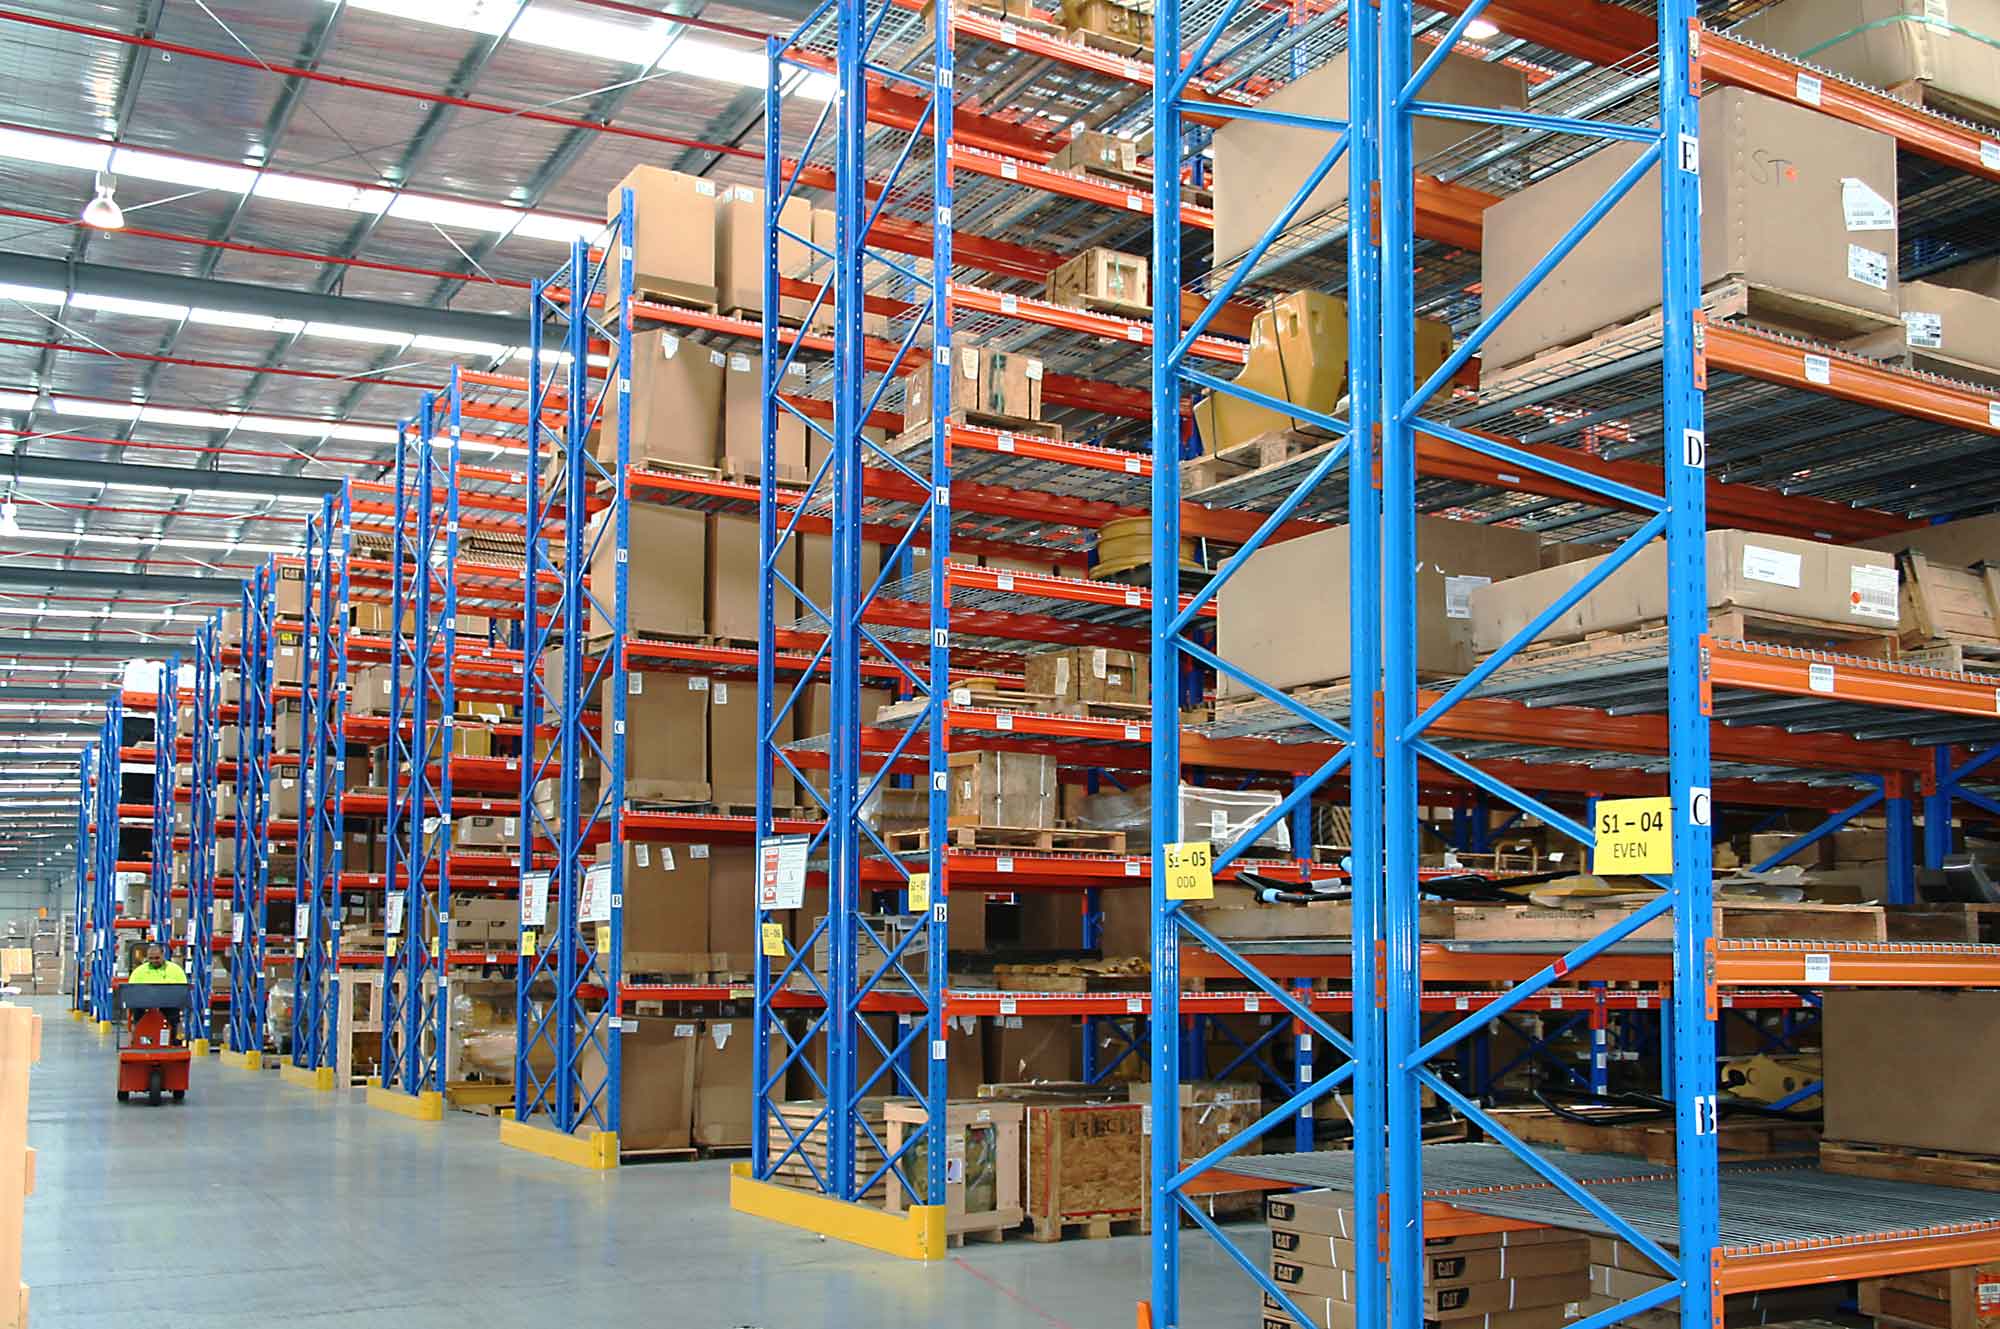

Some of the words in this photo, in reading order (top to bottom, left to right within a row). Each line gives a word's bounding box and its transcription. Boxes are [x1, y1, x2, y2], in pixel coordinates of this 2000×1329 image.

[1687, 435, 1703, 467] D
[937, 632, 946, 646] D
[1692, 794, 1709, 825] C
[1640, 811, 1664, 832] 04
[1613, 842, 1647, 859] EVEN
[936, 906, 946, 921] B
